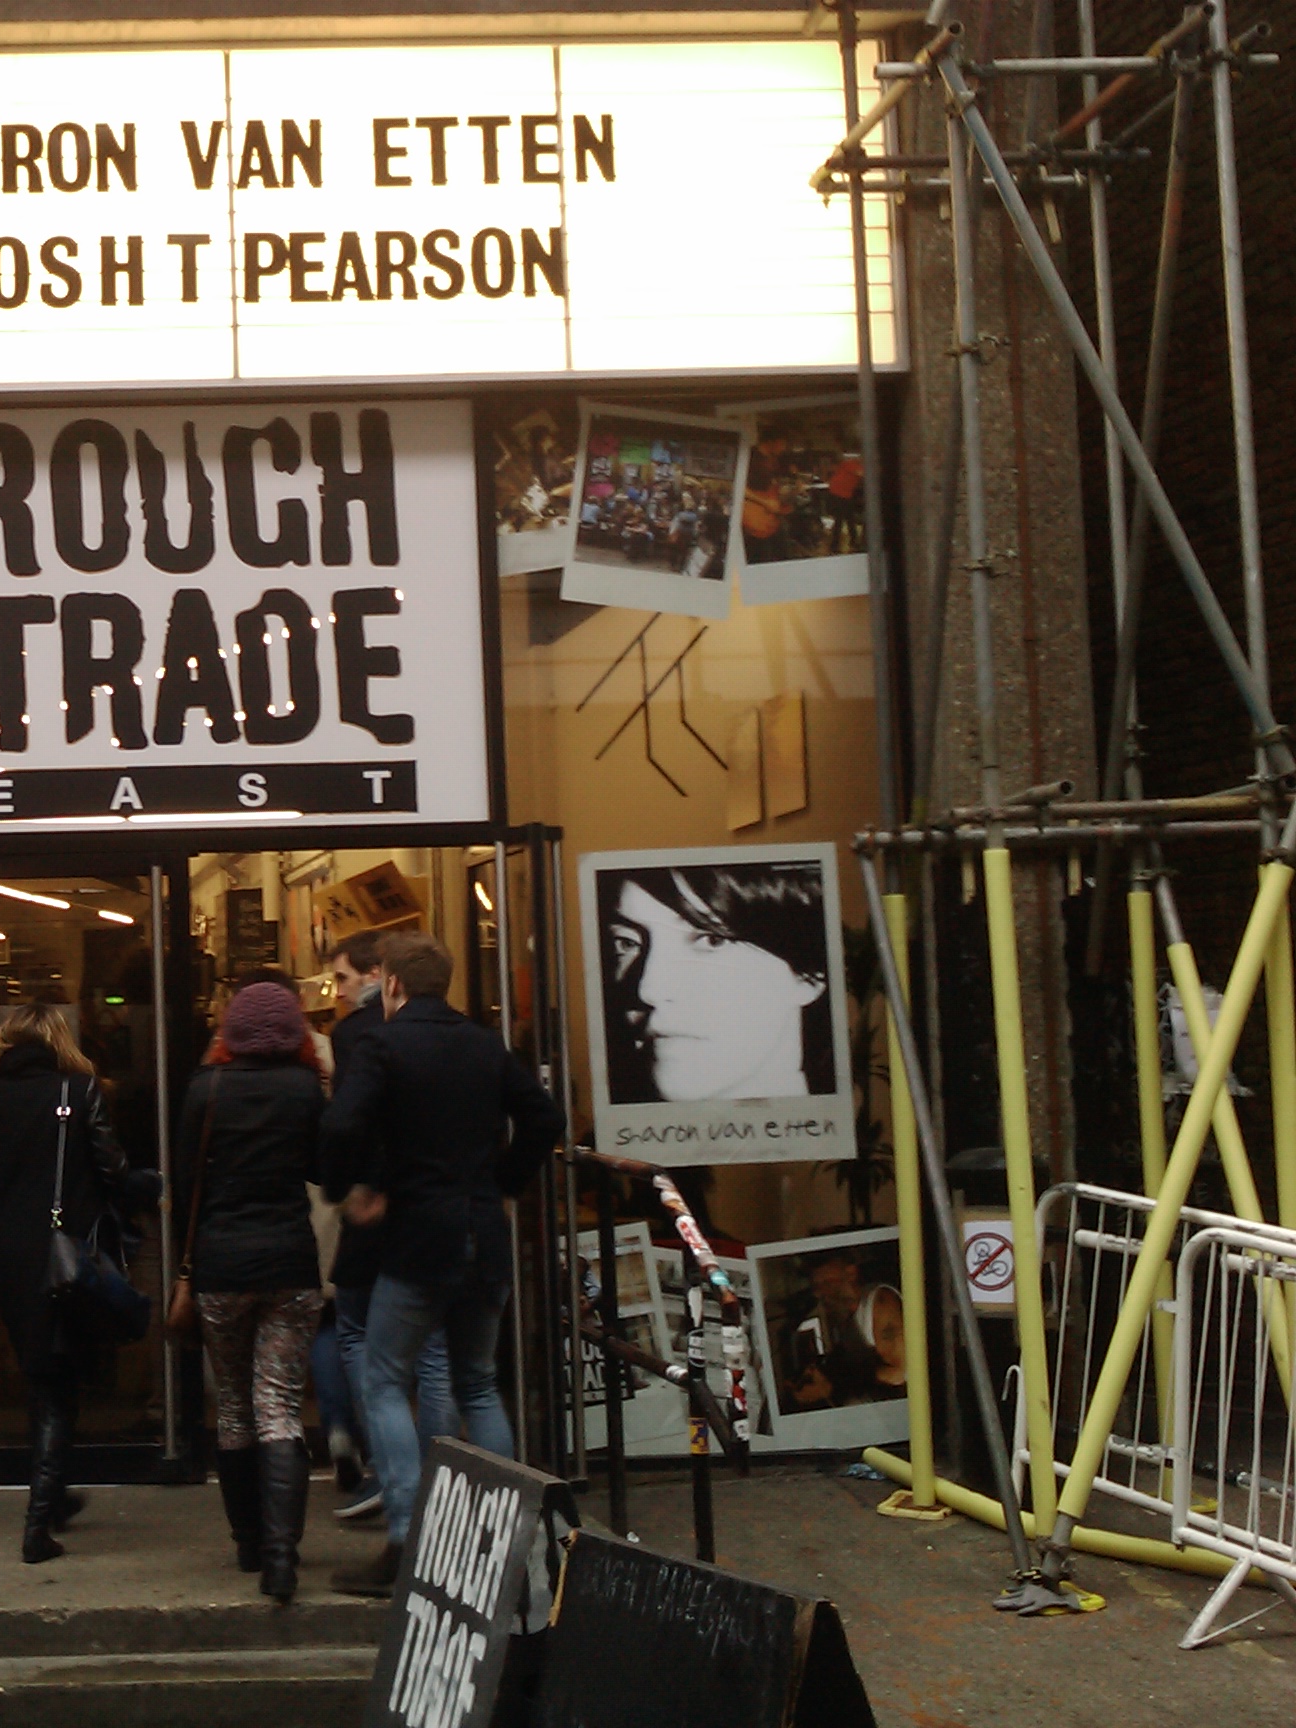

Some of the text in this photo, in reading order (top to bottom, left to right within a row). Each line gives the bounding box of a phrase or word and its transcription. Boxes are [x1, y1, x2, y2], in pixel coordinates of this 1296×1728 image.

[181, 118, 324, 191] VAN
[372, 114, 616, 187] ETTEN
[167, 232, 212, 303] T
[243, 225, 568, 304] PEARSON
[414, 1465, 521, 1622] ROUGH
